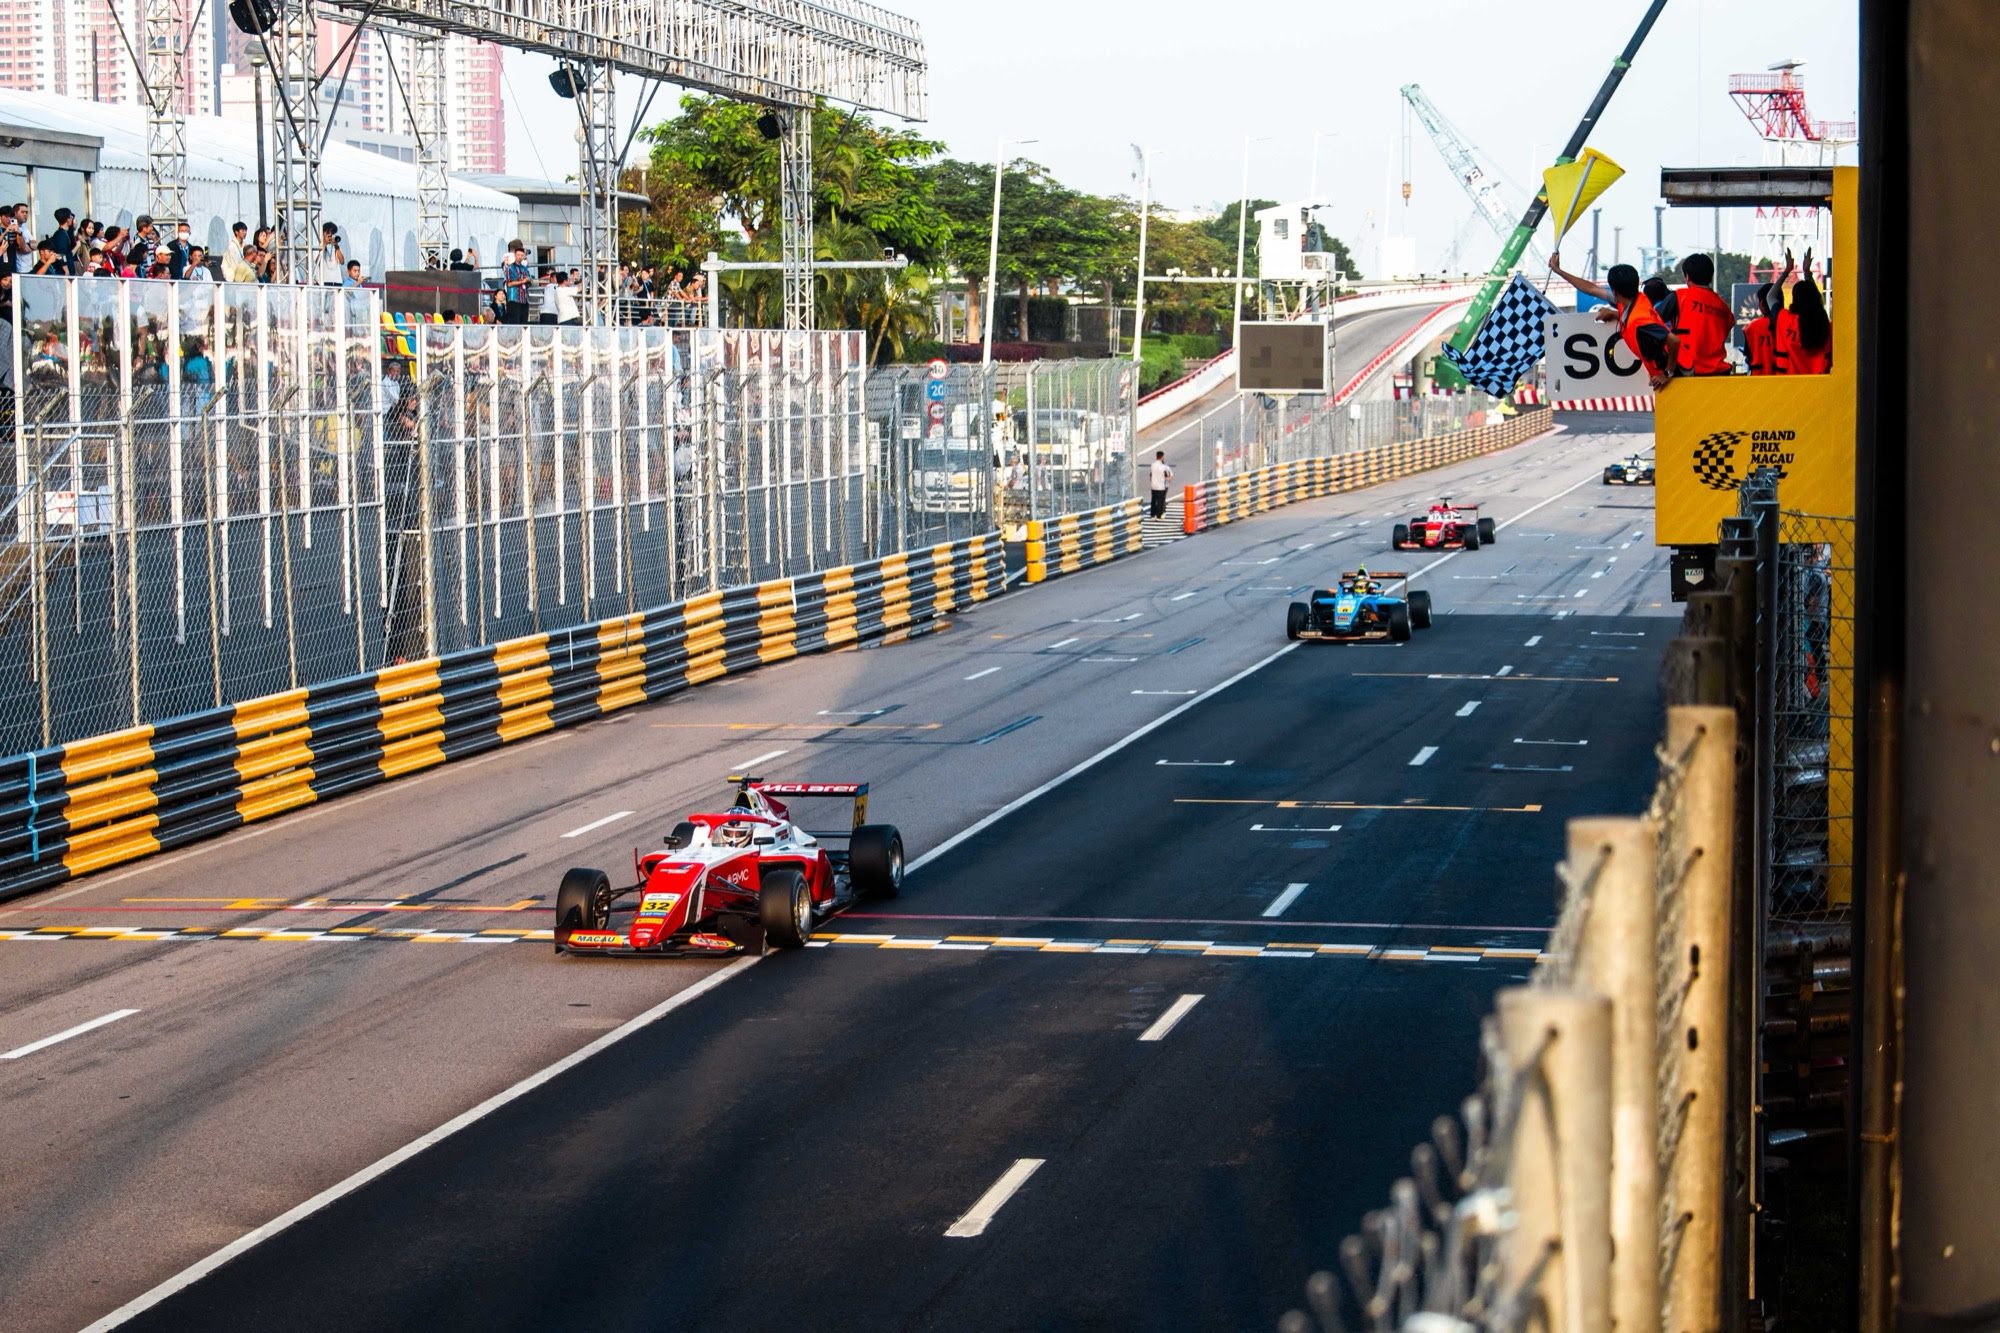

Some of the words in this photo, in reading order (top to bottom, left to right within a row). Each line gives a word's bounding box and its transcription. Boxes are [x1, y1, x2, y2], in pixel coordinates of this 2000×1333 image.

[1564, 333, 1642, 379] SC
[1752, 431, 1795, 440] GRAND
[1751, 442, 1780, 452] PRIX
[1751, 453, 1794, 463] MACAU
[645, 902, 670, 911] 32
[576, 935, 616, 943] MACAU
